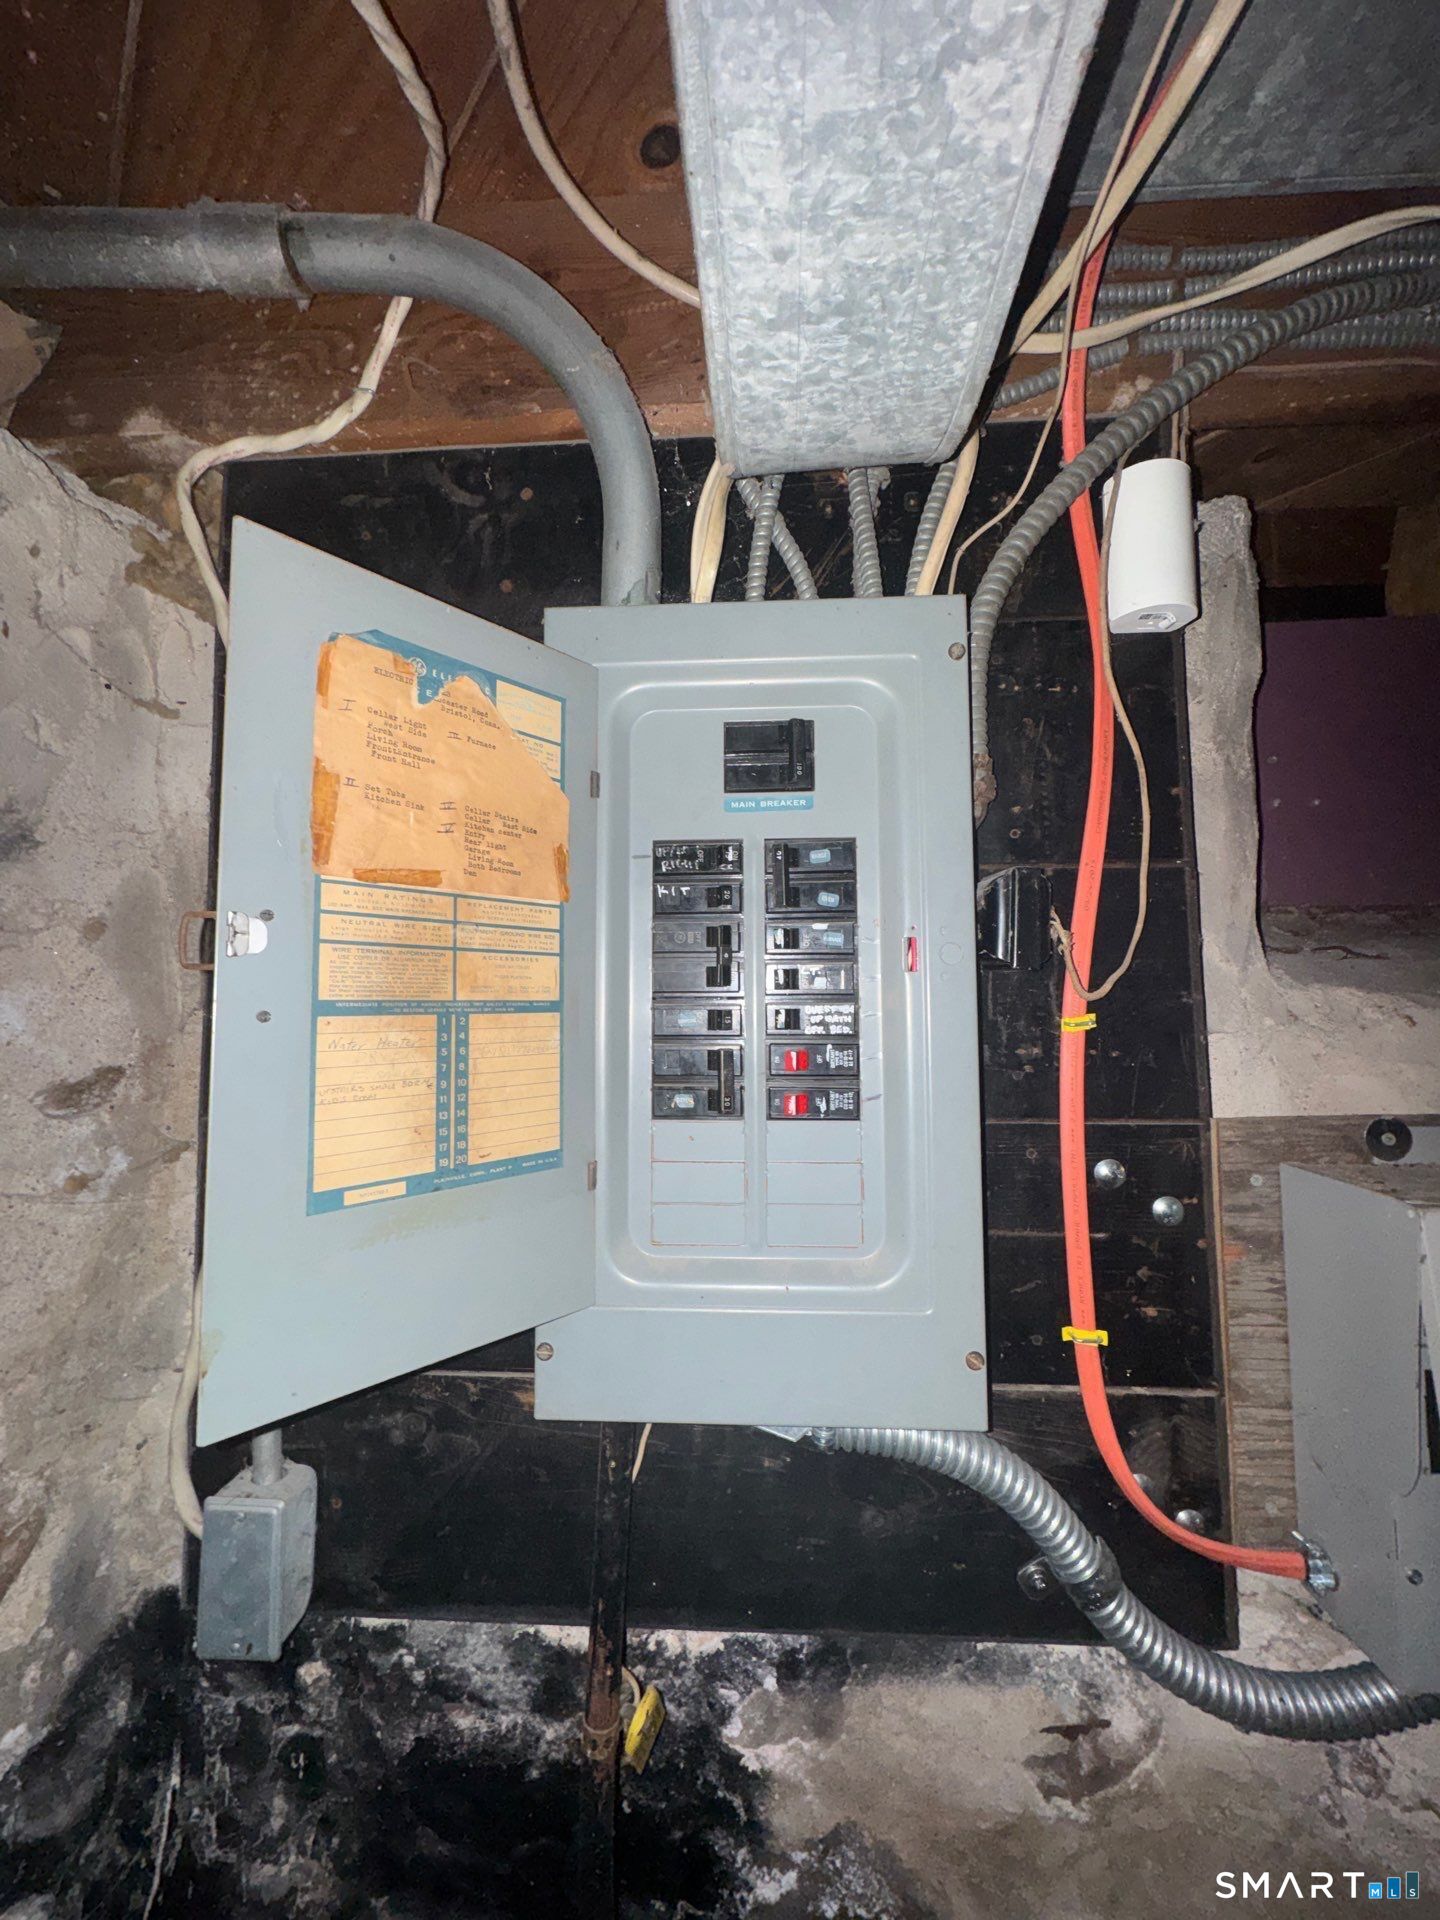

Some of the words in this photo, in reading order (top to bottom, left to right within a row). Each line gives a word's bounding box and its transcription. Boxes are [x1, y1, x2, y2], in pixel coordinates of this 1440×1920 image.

[373, 666, 414, 685] ELECTRIC
[367, 706, 398, 721] Cellar
[404, 717, 427, 730] Light
[367, 732, 398, 748] Living
[402, 740, 422, 752] Room
[466, 736, 497, 750] Furnace
[371, 750, 397, 763] Front
[401, 758, 421, 770] Hall
[364, 784, 381, 793] Set
[386, 787, 406, 799] Tubs
[364, 792, 401, 807] Kitchen
[405, 801, 425, 811] Sink
[731, 801, 756, 809] MAIN
[760, 799, 807, 808] BREAKER
[465, 805, 491, 817] Cellar
[494, 811, 519, 823] Stairs
[465, 813, 491, 825] Cellar
[464, 822, 495, 834] Kitchen
[464, 830, 486, 841] Entry
[486, 841, 507, 851] light
[468, 853, 494, 865] Living
[657, 884, 691, 898] KIT
[724, 890, 731, 900] 20
[343, 889, 374, 898] MAIN
[384, 891, 434, 904] RATINGS
[466, 902, 525, 912] REPLACEMENT
[341, 918, 387, 928] NEUTRAL
[394, 922, 417, 930] WIRE
[422, 924, 443, 932] SIZE
[356, 948, 393, 956] TERMINAL
[395, 950, 447, 958] INFORMATION
[482, 955, 540, 963] ACCESSORIES
[328, 1036, 367, 1052] Water
[377, 1036, 418, 1049] Heater
[458, 1078, 467, 1087] 10
[440, 1095, 447, 1104] 11
[457, 1093, 466, 1102] 12
[724, 1097, 731, 1107] 30
[439, 1111, 448, 1120] 13
[457, 1109, 466, 1118] 14
[439, 1127, 448, 1137] 15
[457, 1125, 466, 1134] 16
[439, 1143, 448, 1152] 17
[457, 1141, 466, 1150] 18
[439, 1158, 448, 1168] 19
[456, 1154, 467, 1164] 20
